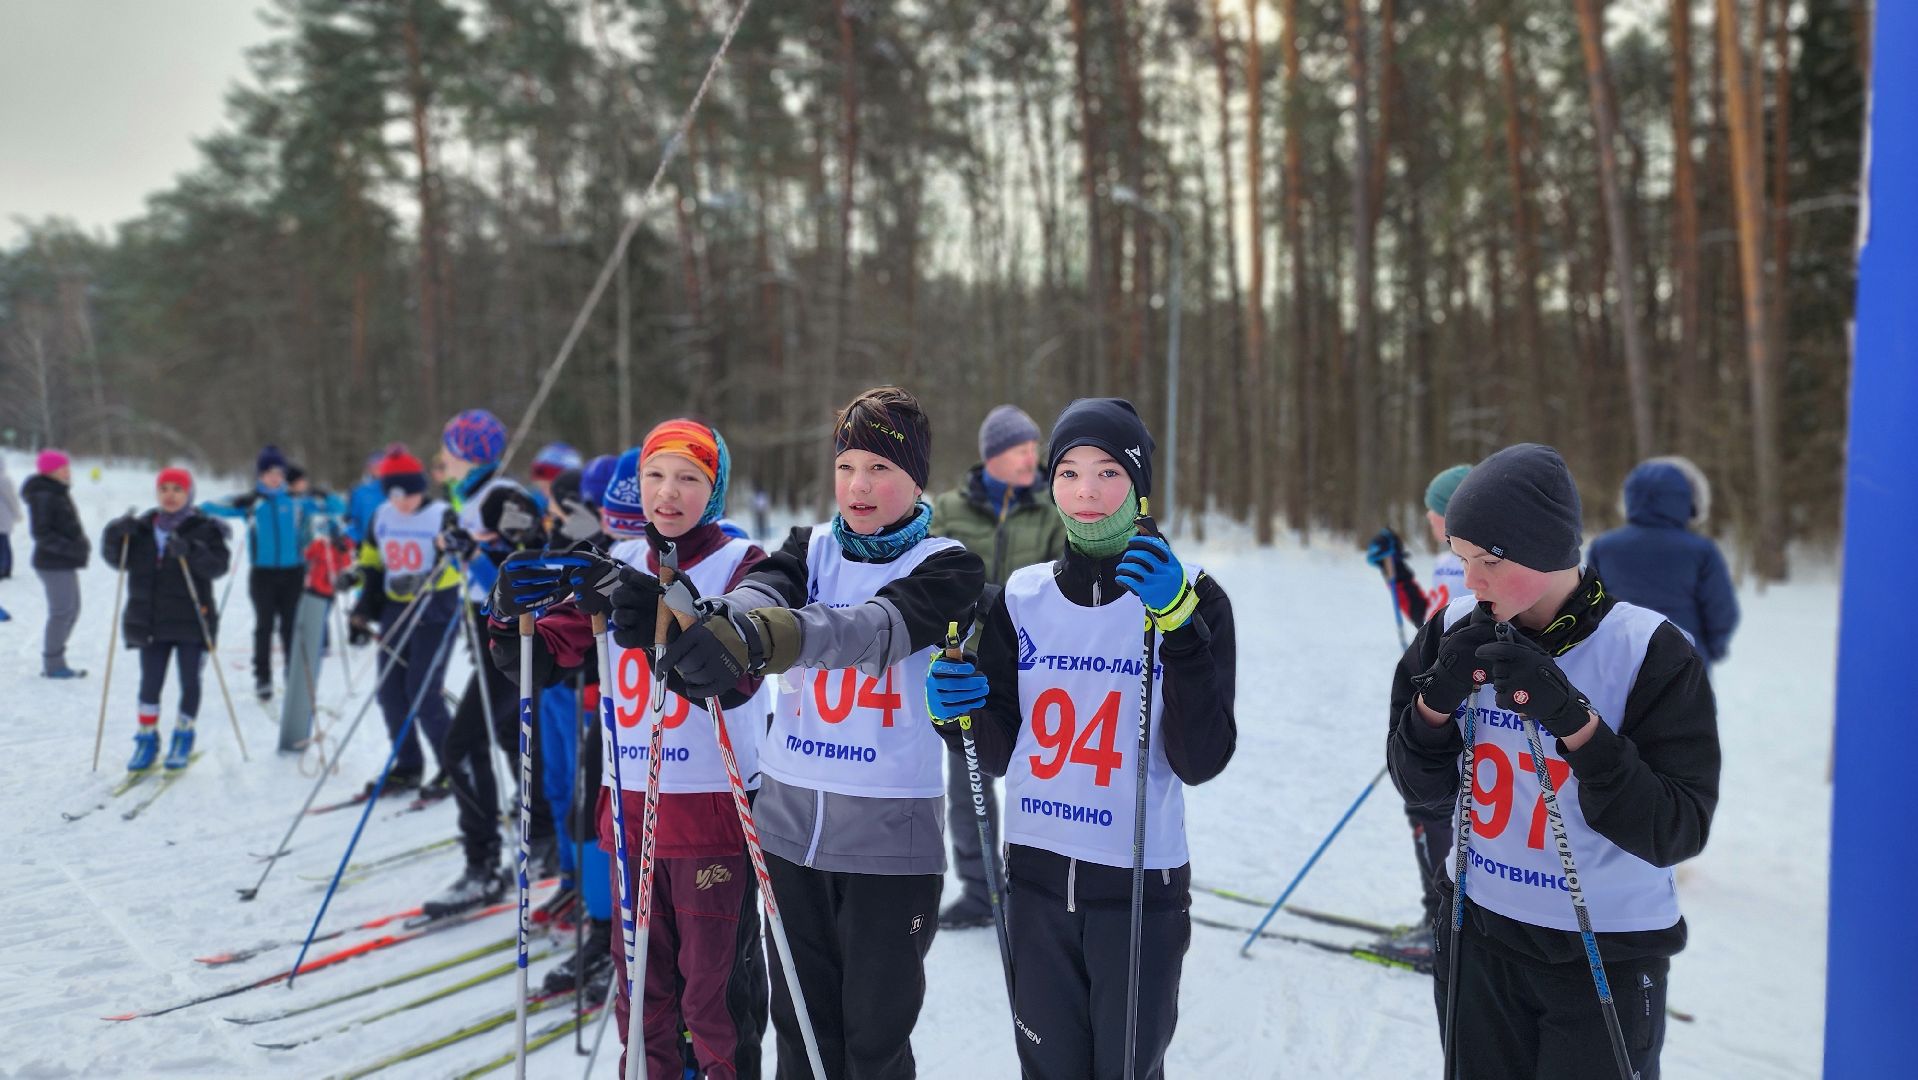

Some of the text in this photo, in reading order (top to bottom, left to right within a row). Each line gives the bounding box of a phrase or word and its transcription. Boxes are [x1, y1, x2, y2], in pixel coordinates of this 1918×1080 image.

[384, 540, 425, 573] 80
[786, 734, 877, 763] ПРОТВИНО
[962, 736, 986, 816] NORDWAY
[1028, 687, 1123, 788] 94
[640, 728, 660, 917] CARRERA
[1021, 797, 1113, 827] ПРОТВИНО
[1469, 742, 1570, 850] 97
[1541, 785, 1587, 908] NORDWAY
